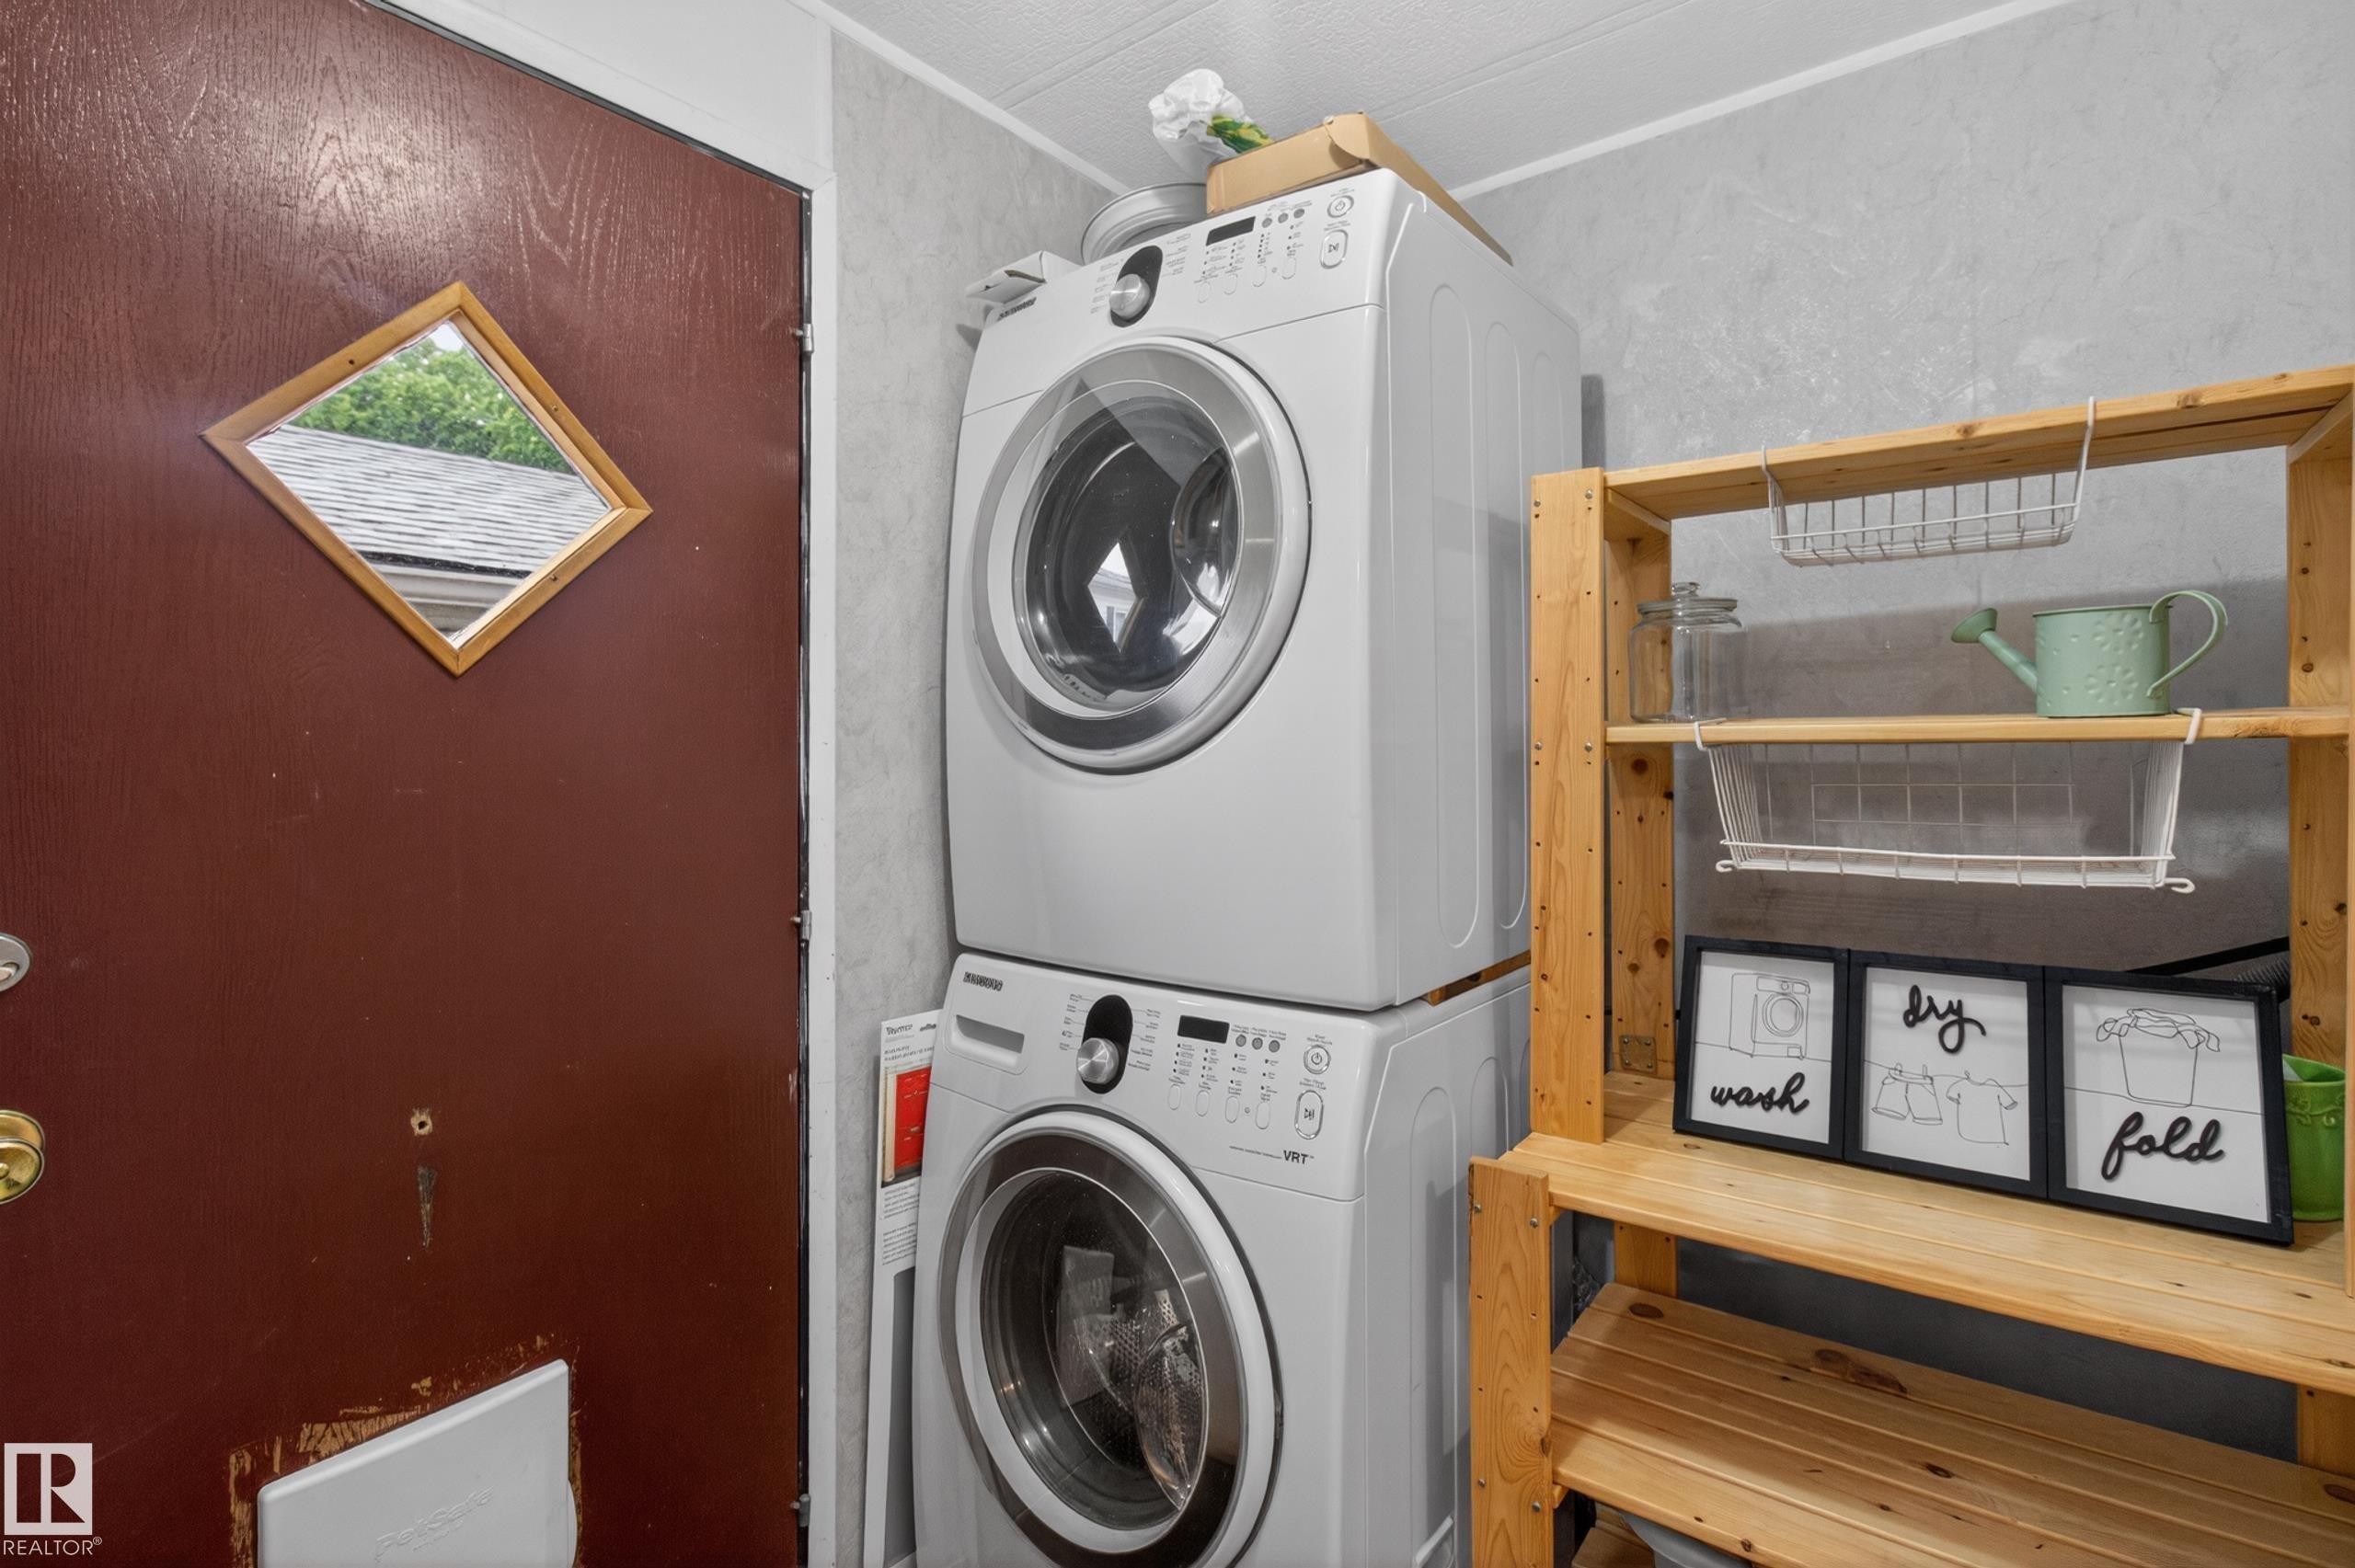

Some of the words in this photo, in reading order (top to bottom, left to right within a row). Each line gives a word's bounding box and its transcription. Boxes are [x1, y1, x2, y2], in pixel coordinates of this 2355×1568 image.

[1902, 984, 1987, 1055] dry
[1710, 1071, 1810, 1115] wash
[2100, 1111, 2224, 1181] fold
